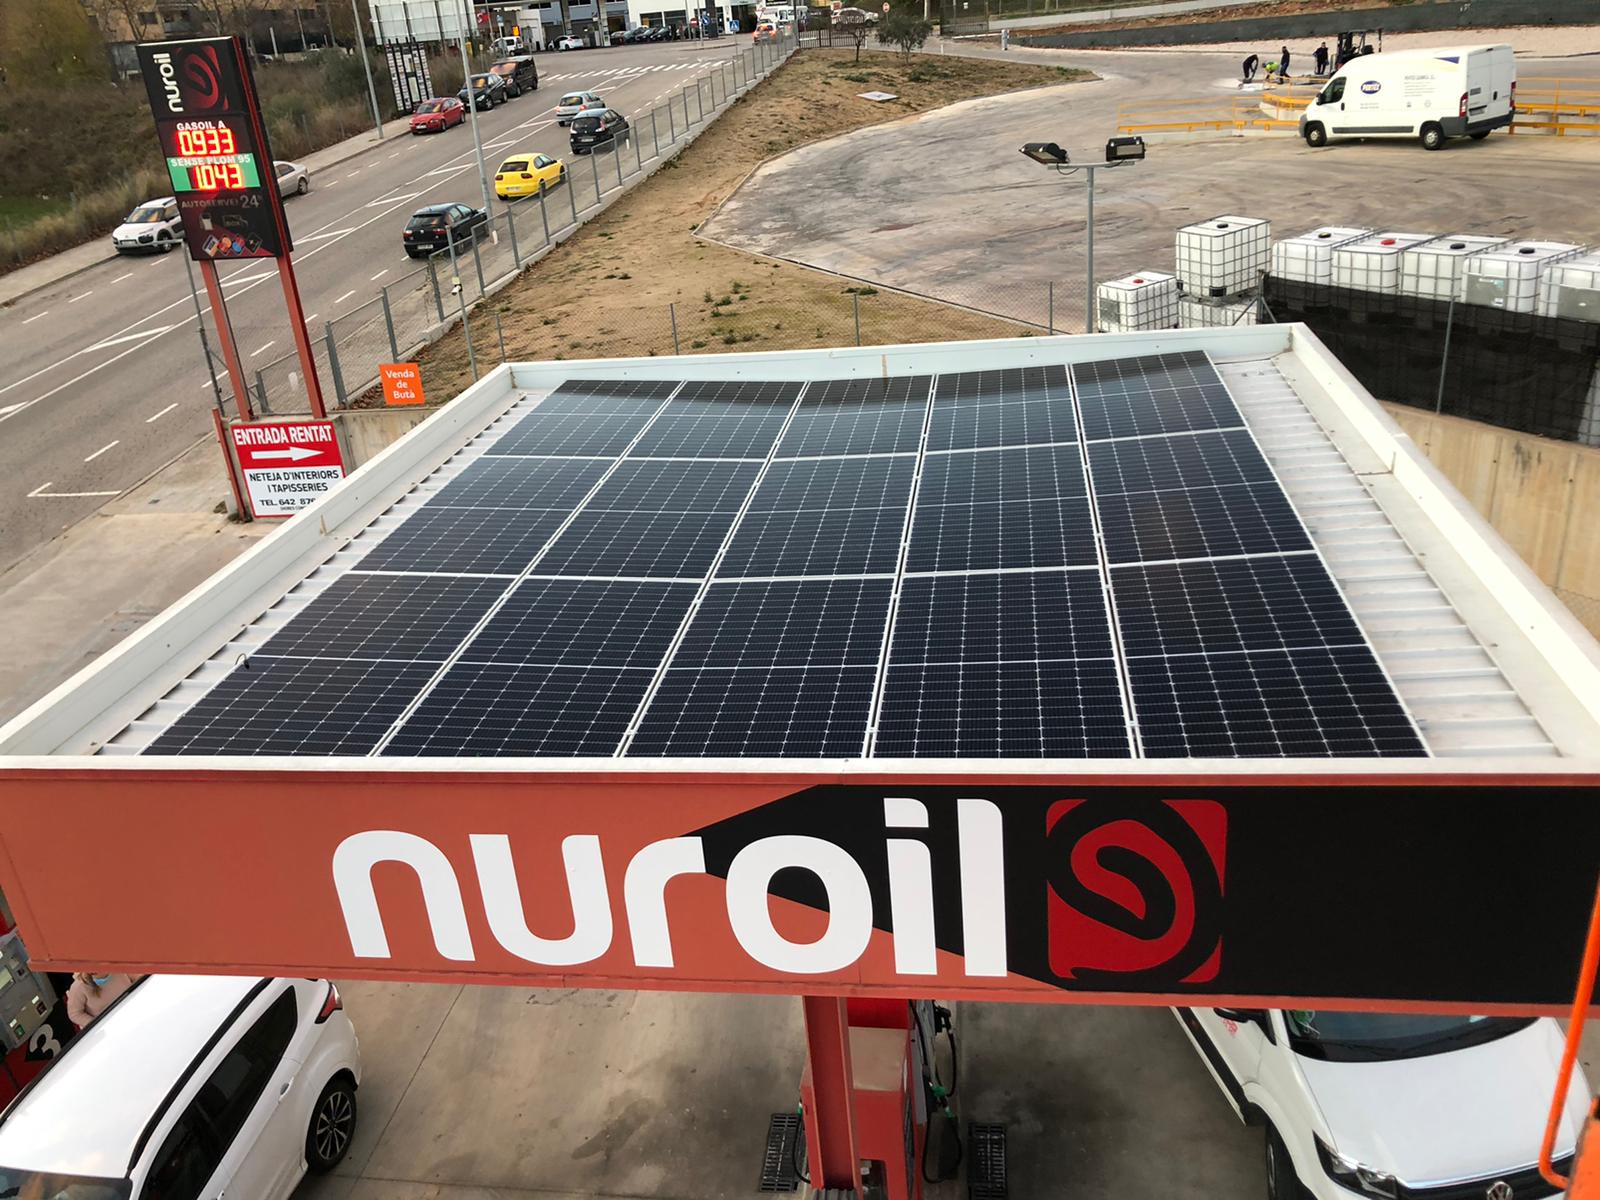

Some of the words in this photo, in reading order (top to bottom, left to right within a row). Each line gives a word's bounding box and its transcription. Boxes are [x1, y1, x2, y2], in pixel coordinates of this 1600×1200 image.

[153, 53, 184, 112] nuroil
[176, 121, 216, 130] GASOIL
[218, 120, 226, 129] A
[171, 157, 205, 167] SENSE
[207, 155, 235, 165] PLOM
[237, 154, 251, 163] 95
[195, 164, 243, 190] 1043
[385, 369, 415, 379] Venda
[396, 379, 408, 389] de
[233, 427, 289, 445] ENTRADA
[288, 425, 332, 443] RENTAT
[249, 472, 282, 481] NETEJA
[283, 470, 339, 480] D'INTERIORS
[267, 484, 271, 493] I
[272, 482, 328, 493] TAPISSERIES
[278, 498, 295, 506] 642
[332, 797, 1008, 977] nuroil
